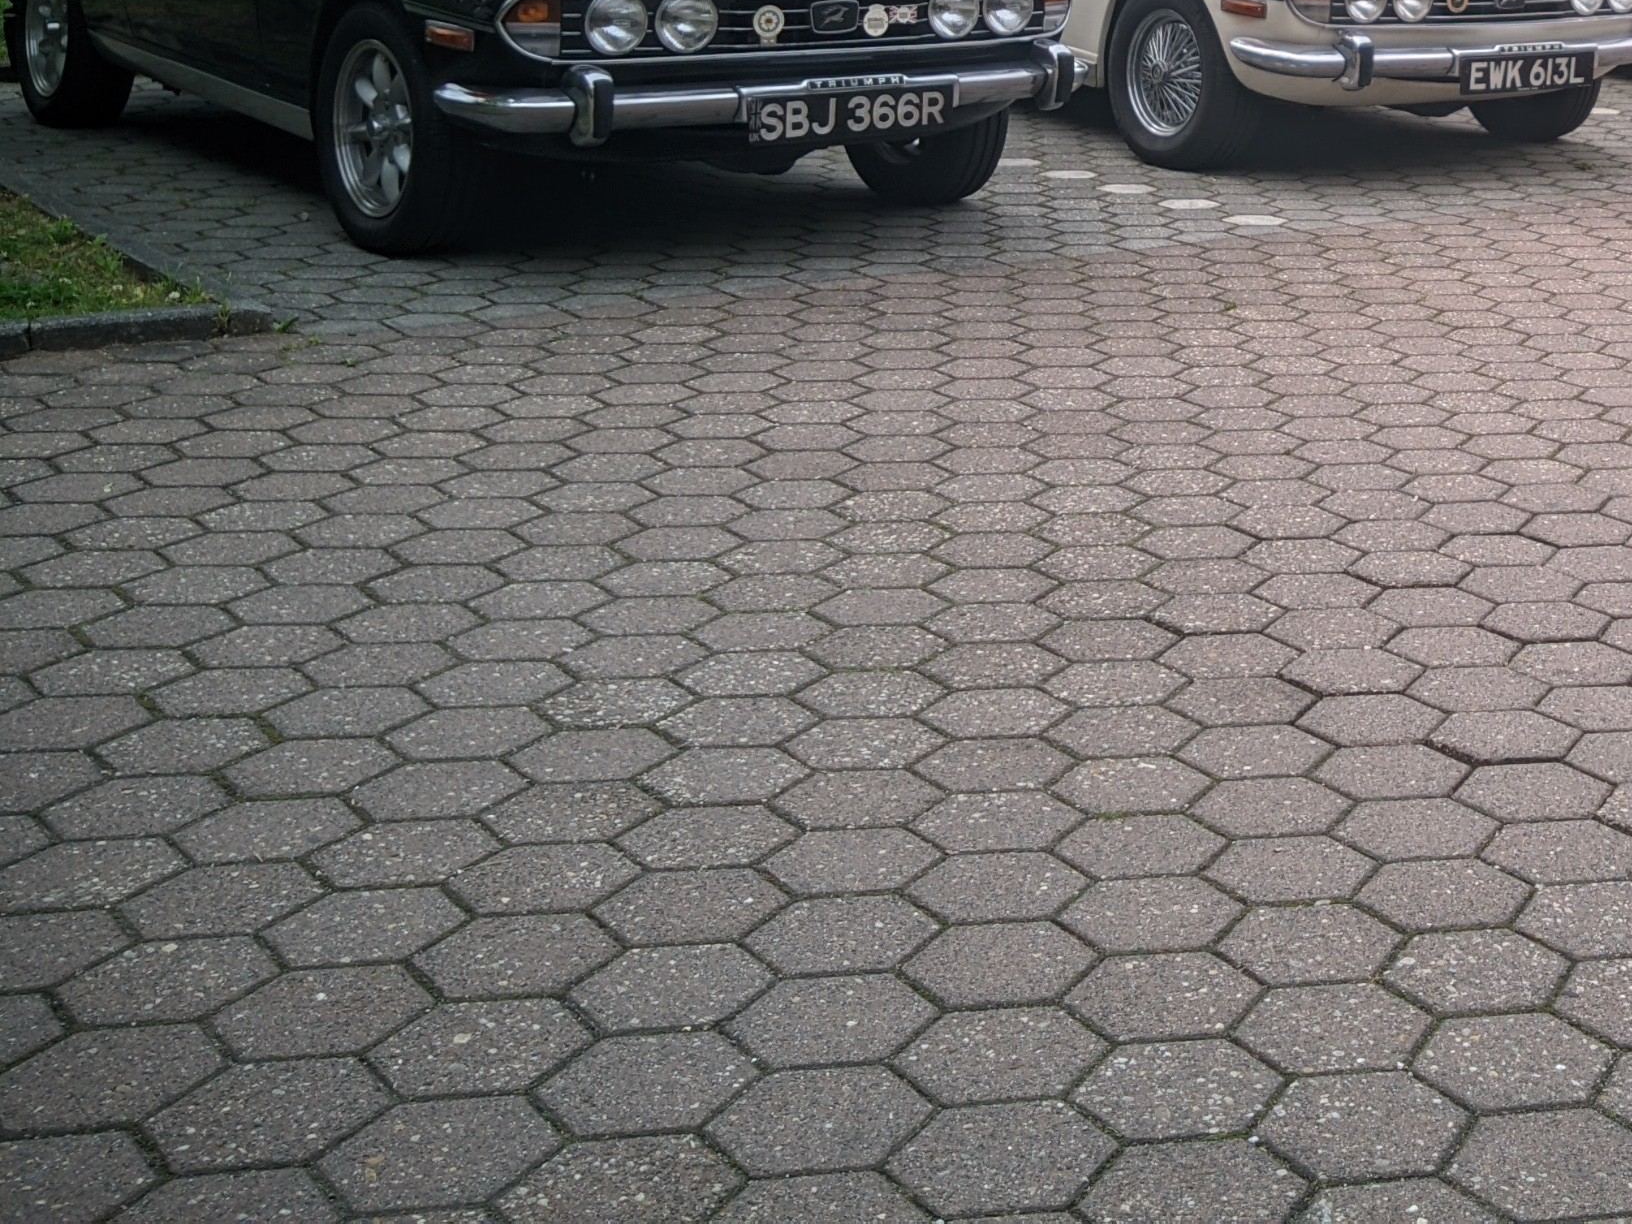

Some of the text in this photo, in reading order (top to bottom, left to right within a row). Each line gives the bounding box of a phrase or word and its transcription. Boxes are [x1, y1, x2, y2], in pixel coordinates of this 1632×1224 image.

[815, 76, 900, 89] TRIUMPH
[1469, 55, 1585, 91] EWK 613L
[759, 91, 945, 141] SBJ 366R
